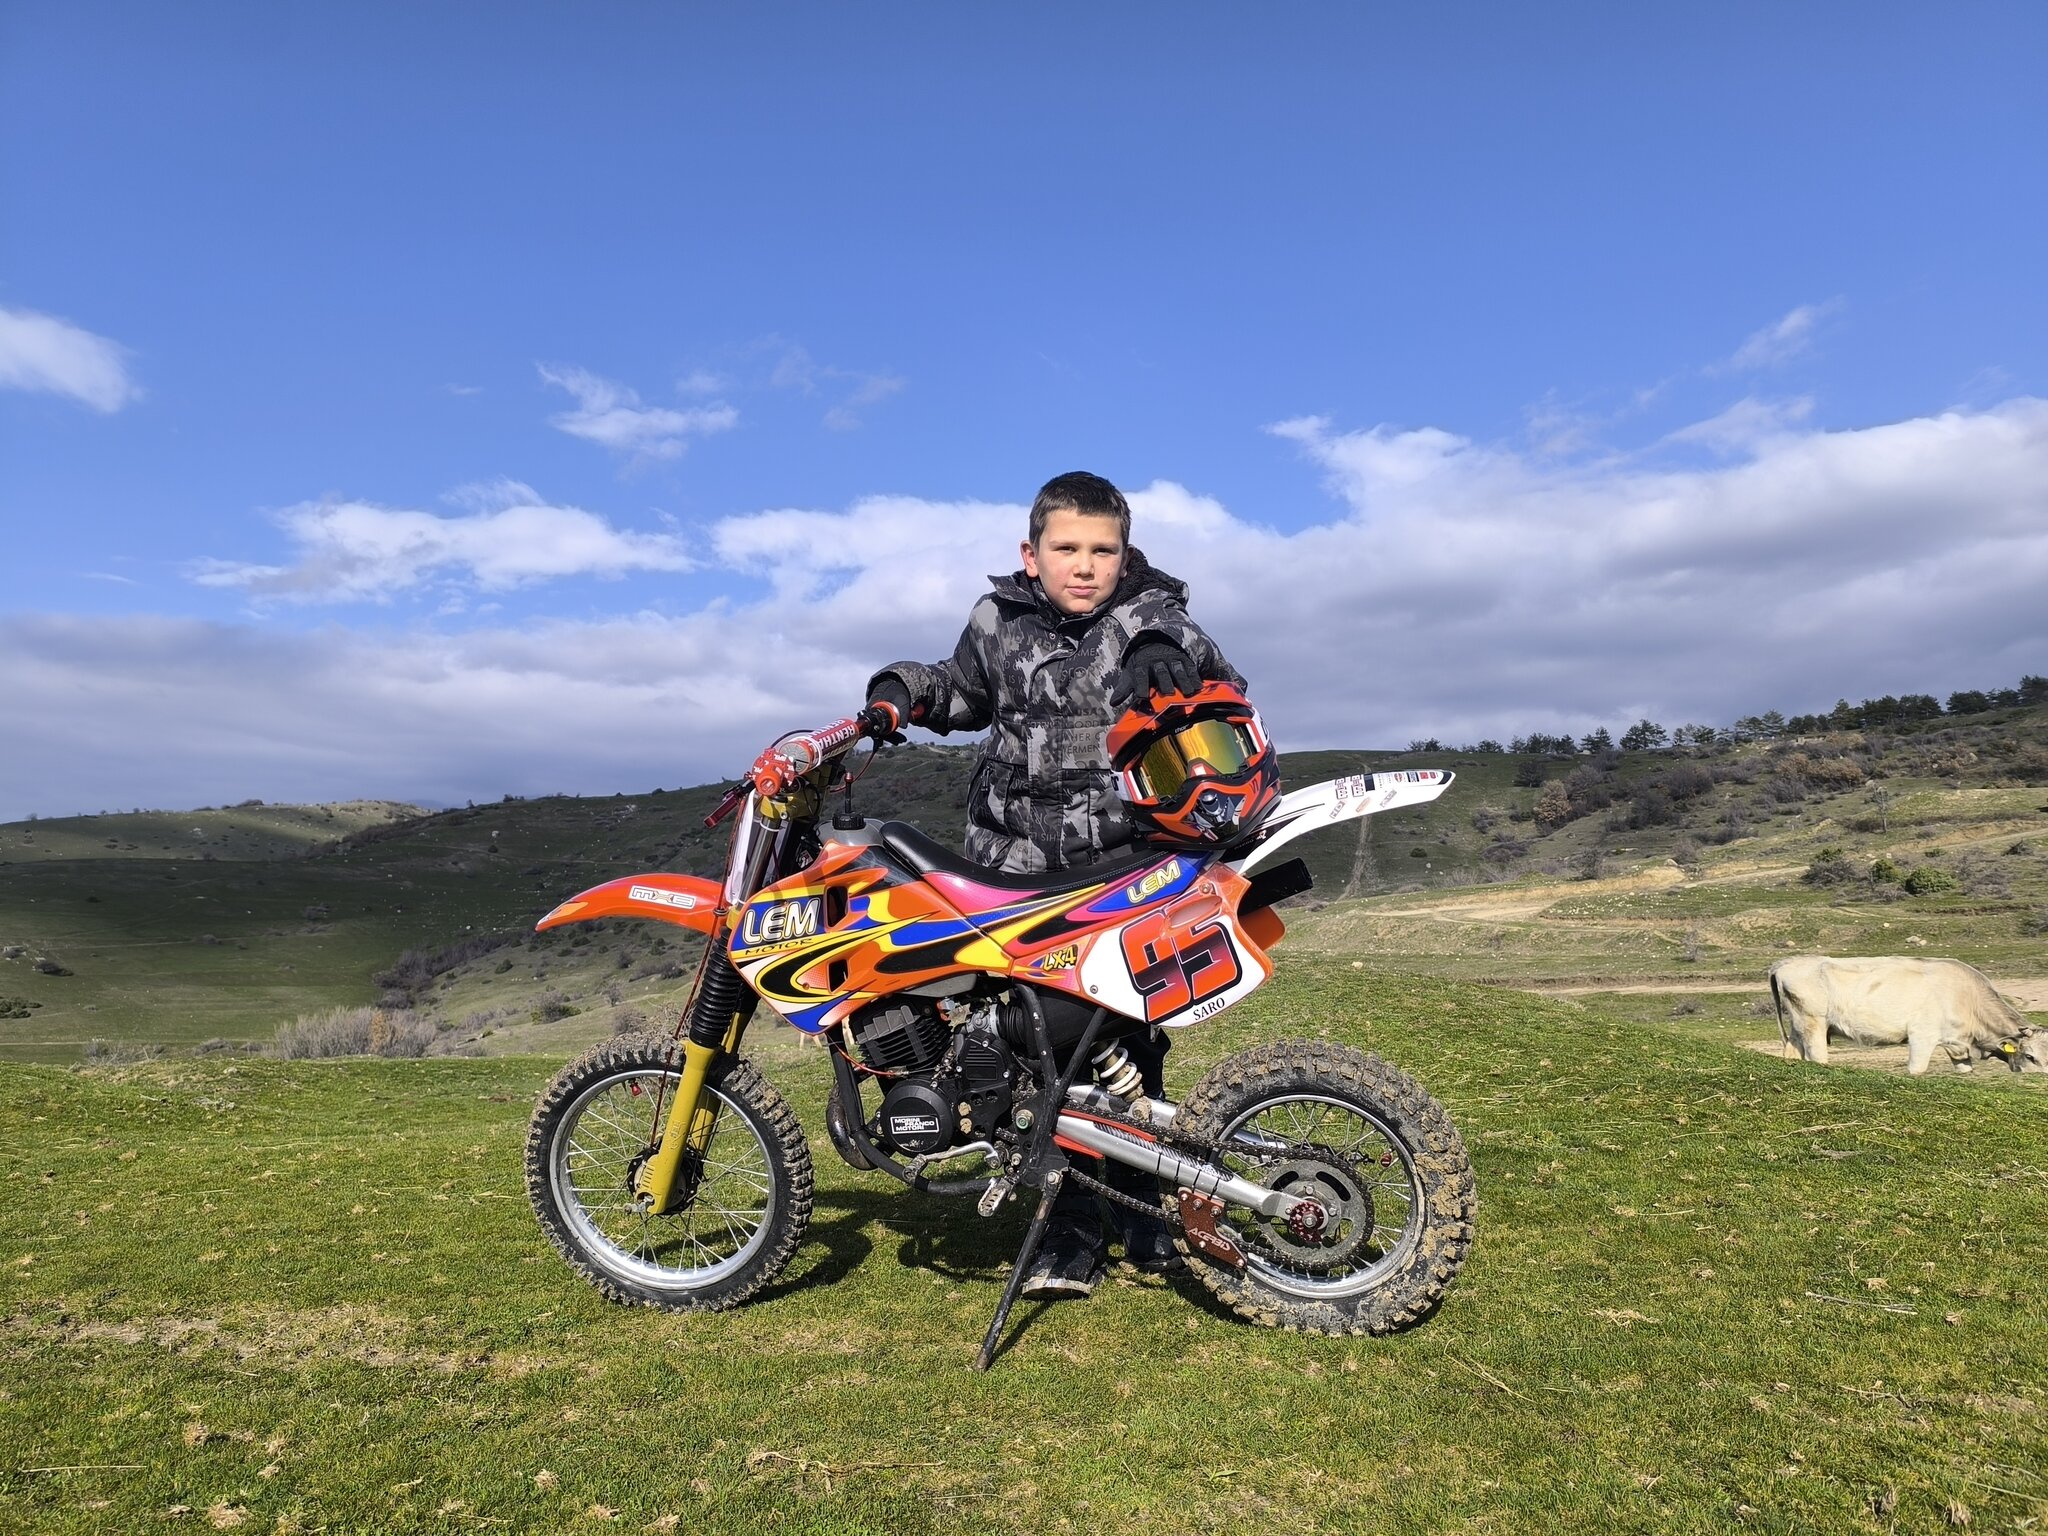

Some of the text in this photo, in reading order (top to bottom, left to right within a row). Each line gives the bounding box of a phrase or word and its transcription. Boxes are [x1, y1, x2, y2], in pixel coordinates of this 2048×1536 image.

[1126, 859, 1182, 904] LEM
[742, 898, 821, 945] LEM
[745, 938, 814, 956] MOTOR
[1042, 943, 1079, 972] LX4
[1119, 908, 1243, 1025] 95
[1192, 996, 1226, 1021] SARO
